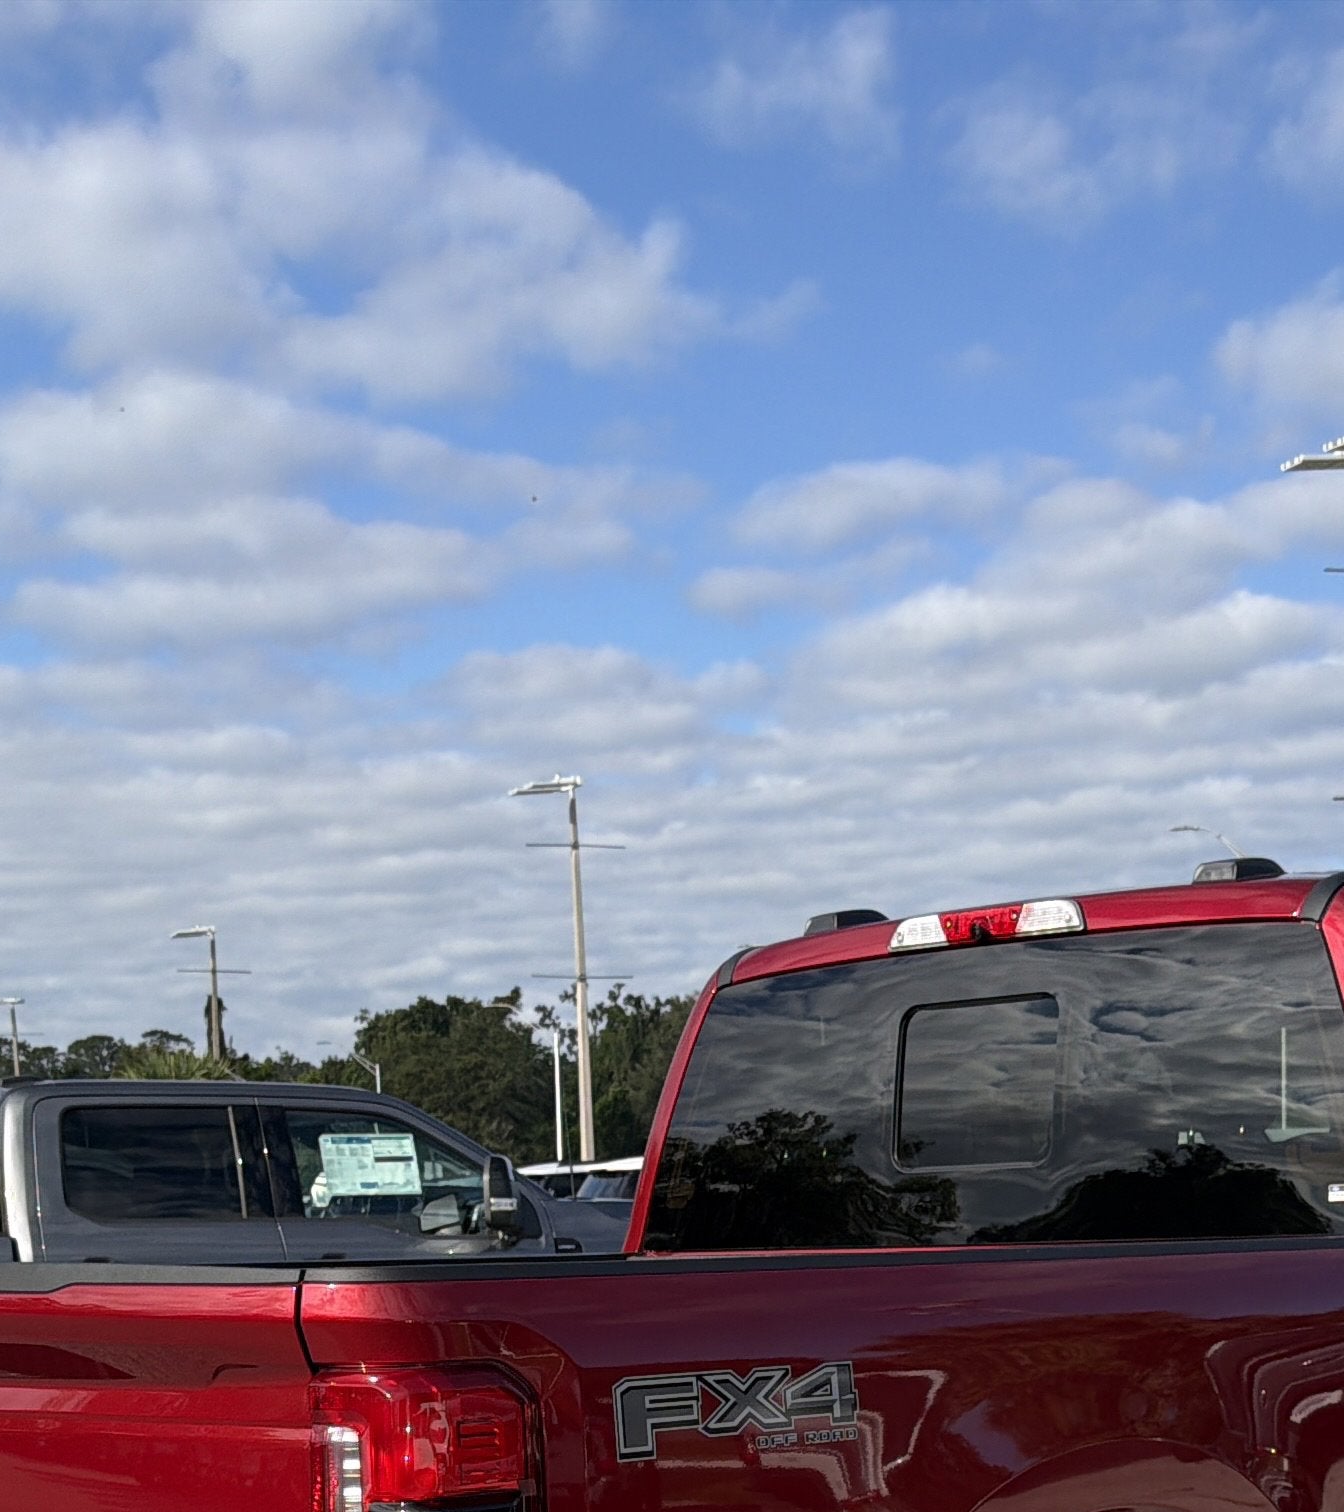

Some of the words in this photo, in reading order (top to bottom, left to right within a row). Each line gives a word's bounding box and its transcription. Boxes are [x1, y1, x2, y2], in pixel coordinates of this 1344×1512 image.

[613, 1361, 858, 1463] FX4
[755, 1432, 798, 1449] OFF
[803, 1427, 858, 1444] ROAD
